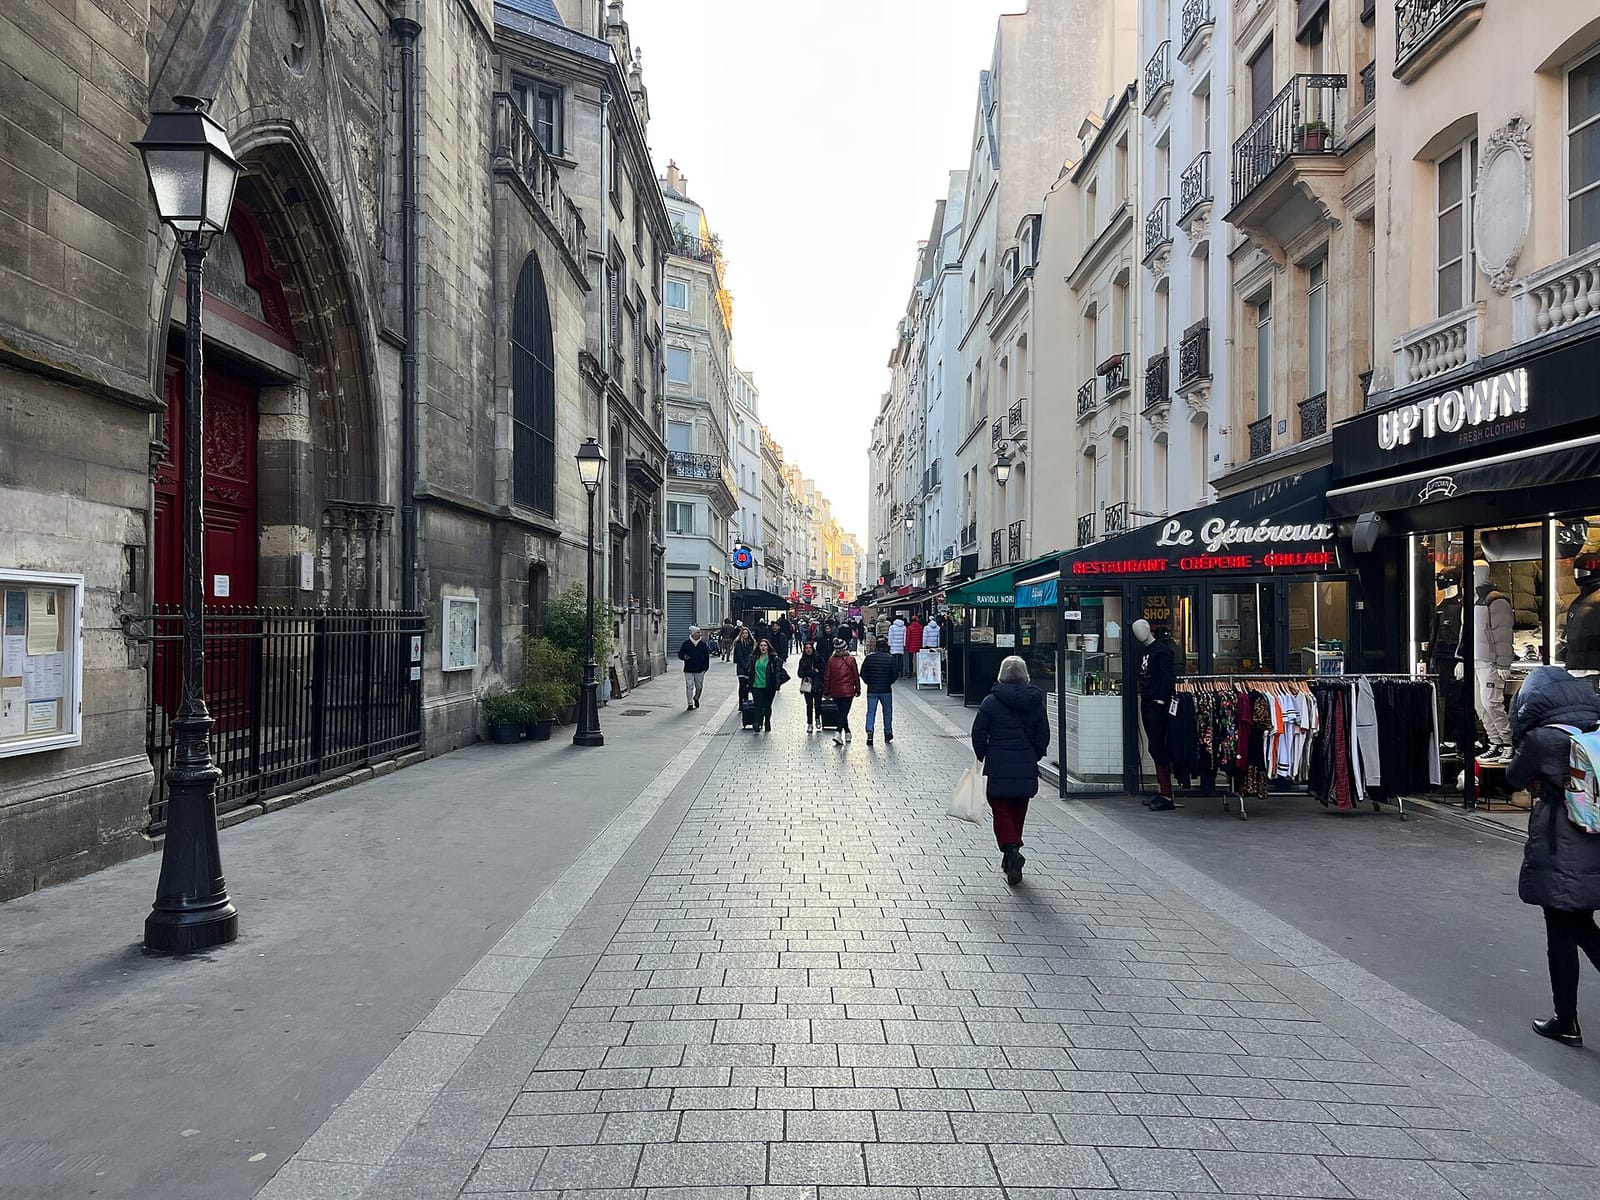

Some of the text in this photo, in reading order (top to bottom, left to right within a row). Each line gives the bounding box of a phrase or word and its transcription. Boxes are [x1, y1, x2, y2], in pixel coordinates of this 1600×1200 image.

[1377, 367, 1528, 450] UPTOWN
[1458, 418, 1526, 444] FRESH CLOTHING
[1156, 517, 1334, 552] Le Généreux
[1072, 558, 1168, 575] RESTAURANT
[1180, 553, 1252, 571] CRÊPERIE
[1263, 551, 1335, 568] GRILLADE
[976, 595, 999, 603] RAVIOLI
[1147, 595, 1167, 607] SEX
[1143, 608, 1170, 620] SHOP
